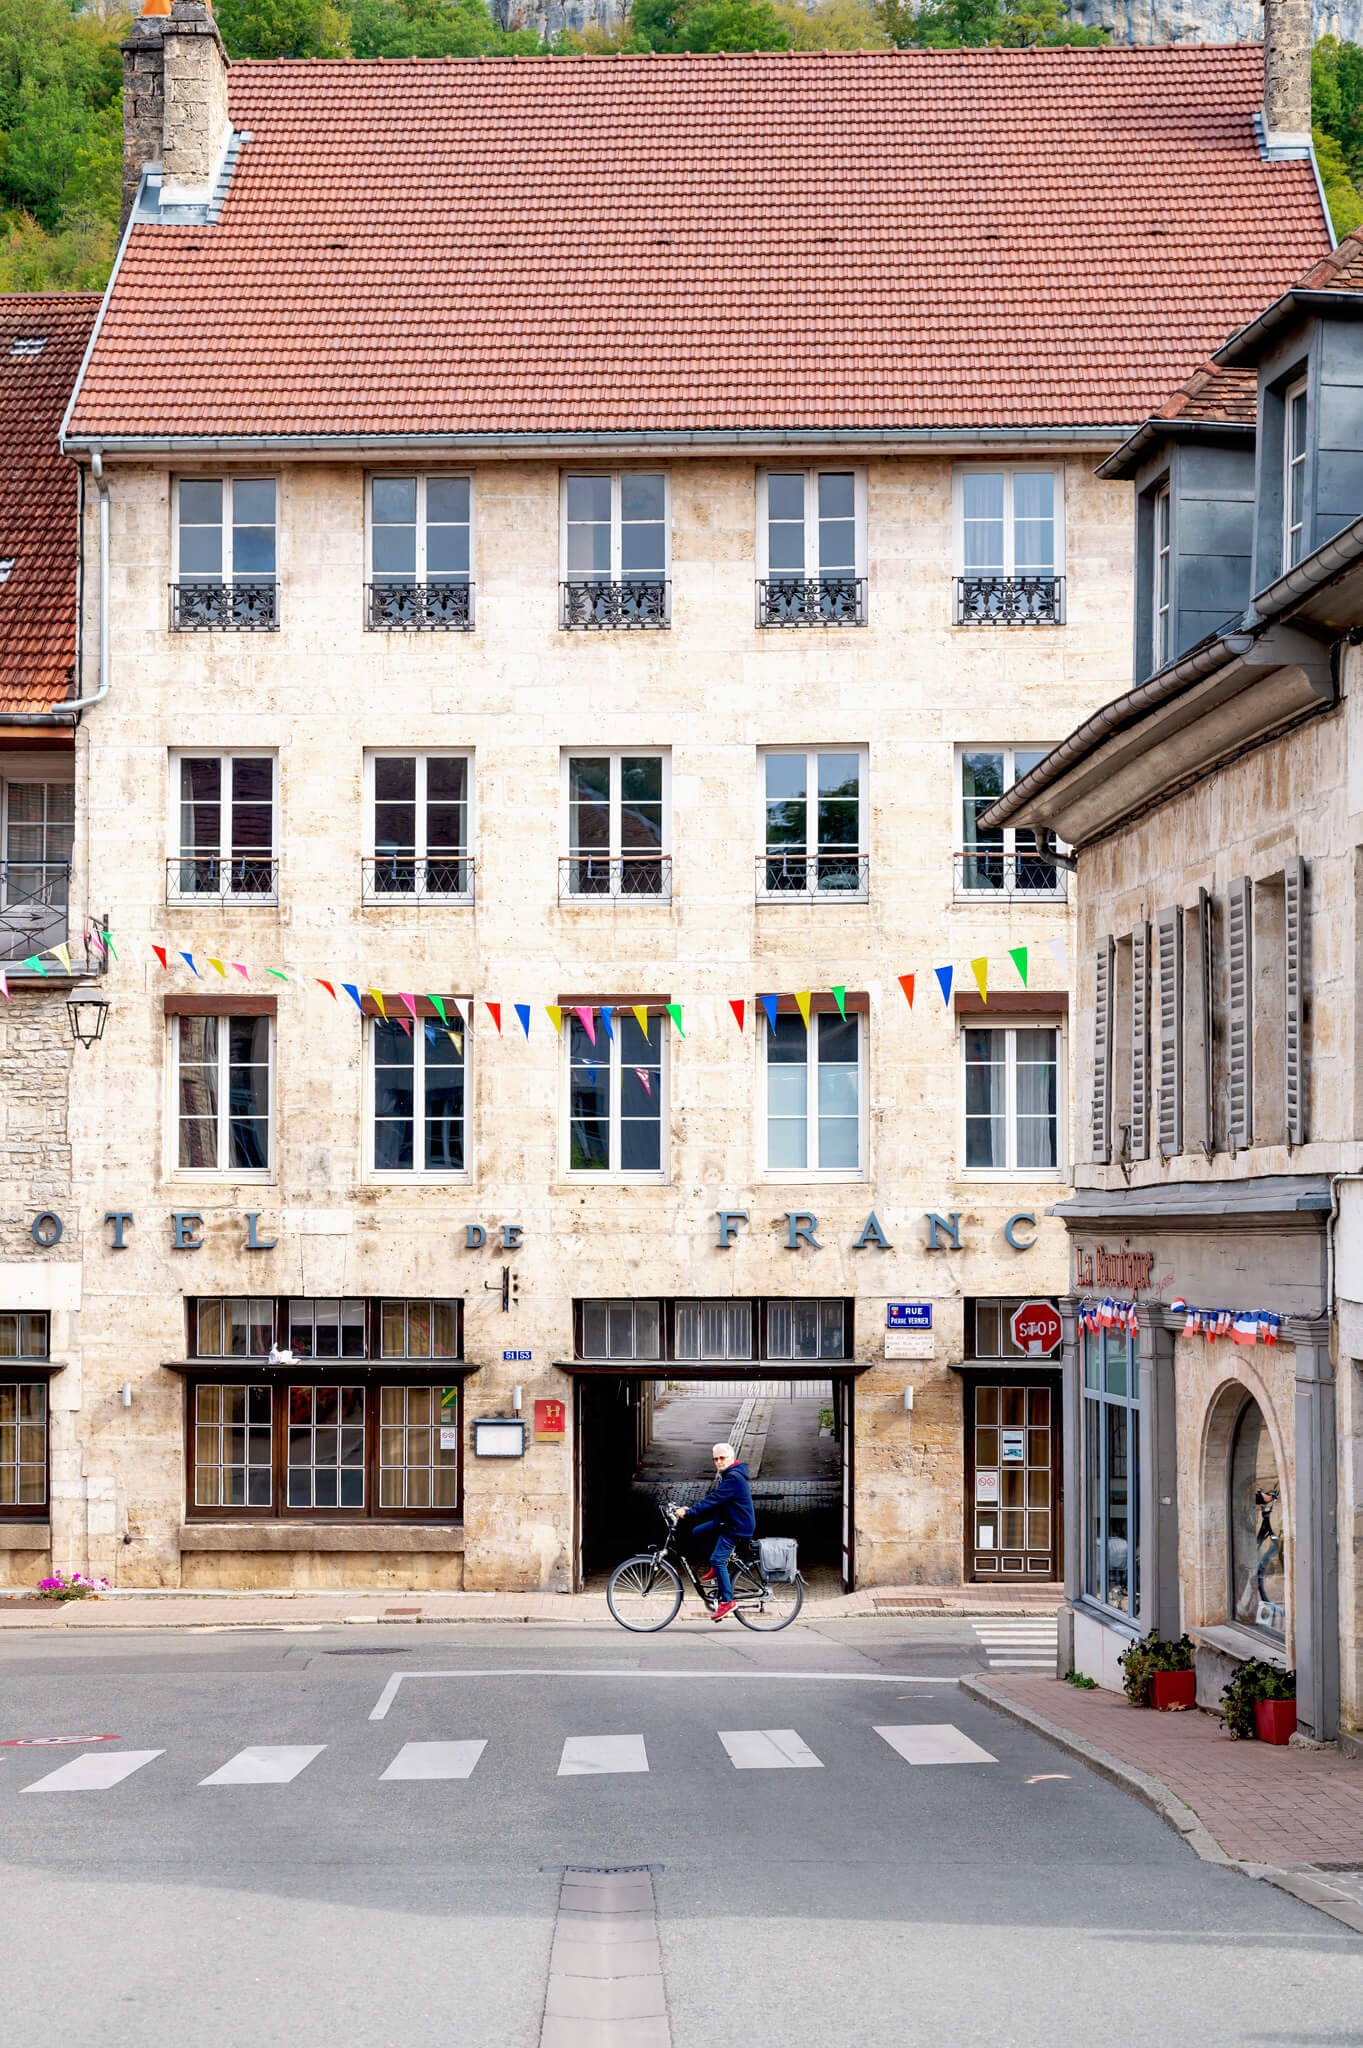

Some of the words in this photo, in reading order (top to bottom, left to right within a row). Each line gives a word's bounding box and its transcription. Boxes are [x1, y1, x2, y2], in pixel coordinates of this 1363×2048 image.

[464, 1224, 524, 1249] DE
[1074, 1245, 1092, 1287] La
[1094, 1236, 1153, 1301] Boutique
[905, 1307, 923, 1315] RUE
[1019, 1320, 1058, 1337] STOP
[519, 1351, 530, 1359] 53
